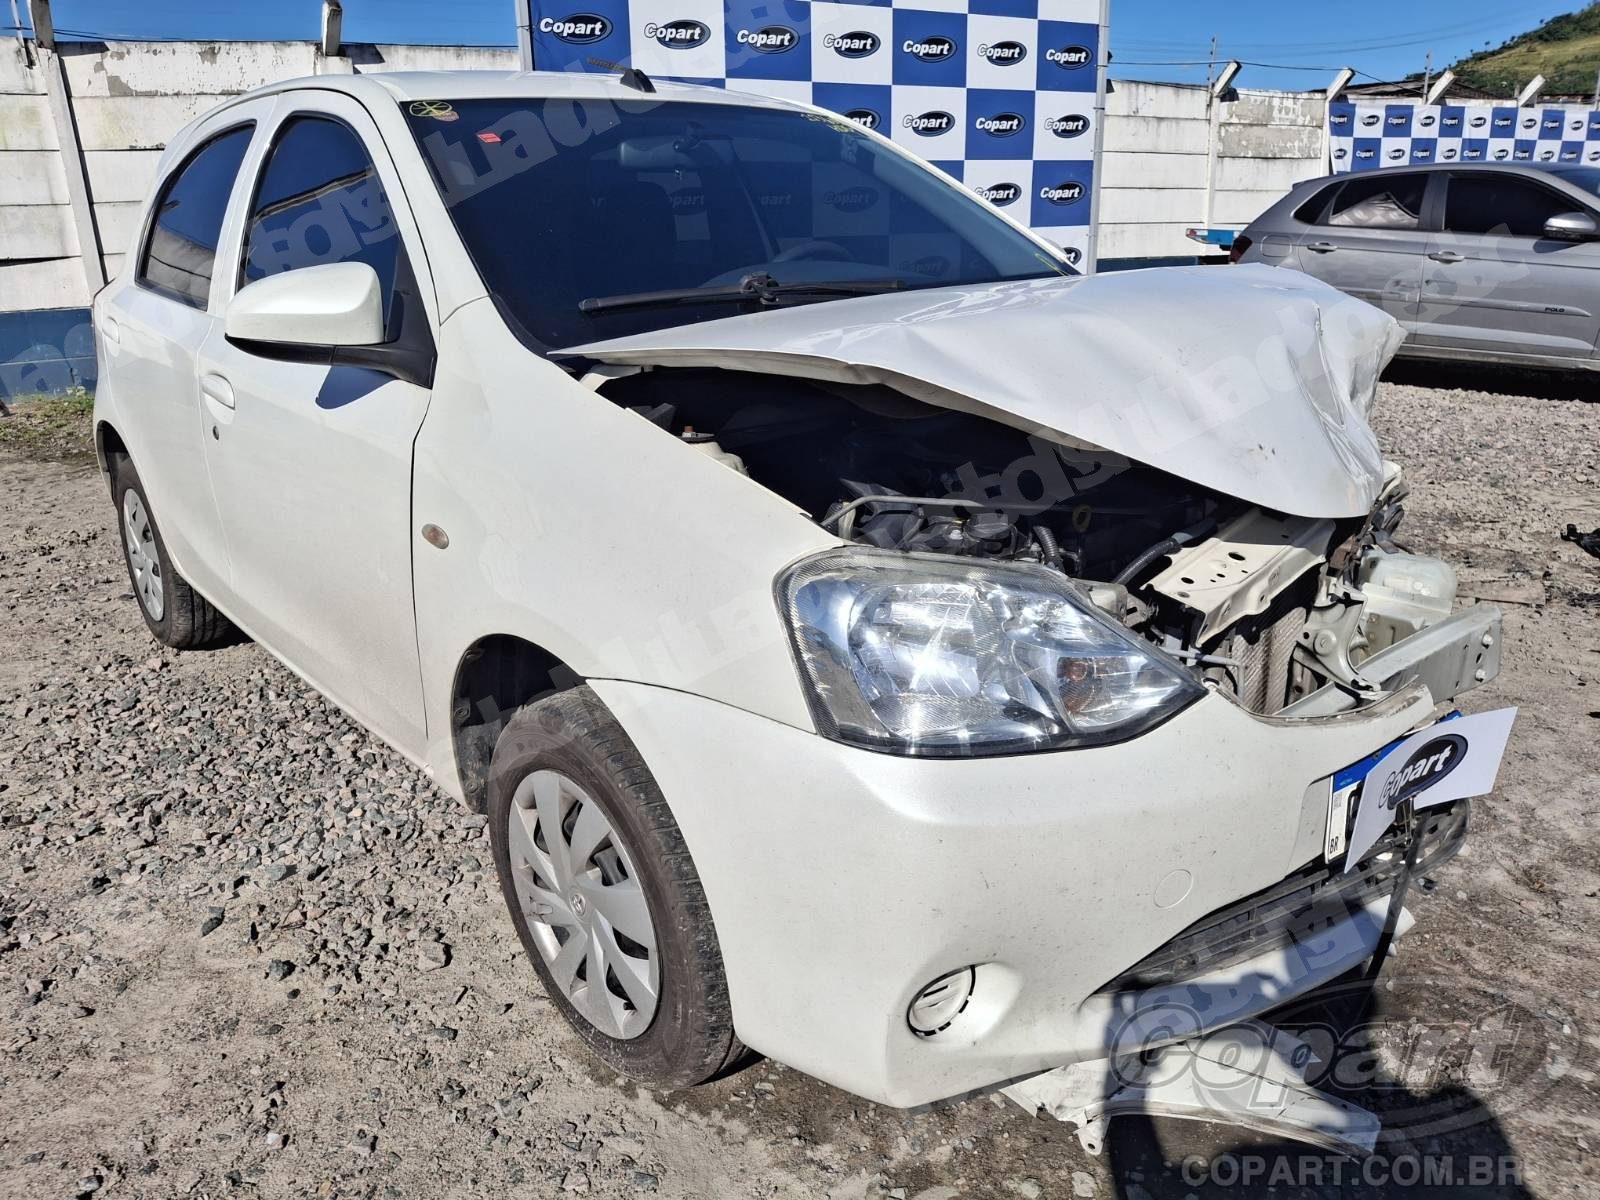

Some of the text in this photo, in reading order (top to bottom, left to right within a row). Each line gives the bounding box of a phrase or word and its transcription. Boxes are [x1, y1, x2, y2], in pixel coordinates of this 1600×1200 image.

[540, 17, 602, 36] Copart
[643, 23, 701, 41] Copart
[737, 30, 791, 46] Copart
[823, 34, 872, 51] Copart
[903, 40, 950, 56] Copart
[977, 44, 1019, 59] Copart
[1046, 49, 1086, 64] Copart
[903, 115, 949, 130] Copart
[975, 117, 1019, 132] Copart
[1044, 118, 1084, 132] Copart
[975, 187, 1015, 201] Copart
[1040, 187, 1081, 201] Copart
[1378, 744, 1453, 810] Copart
